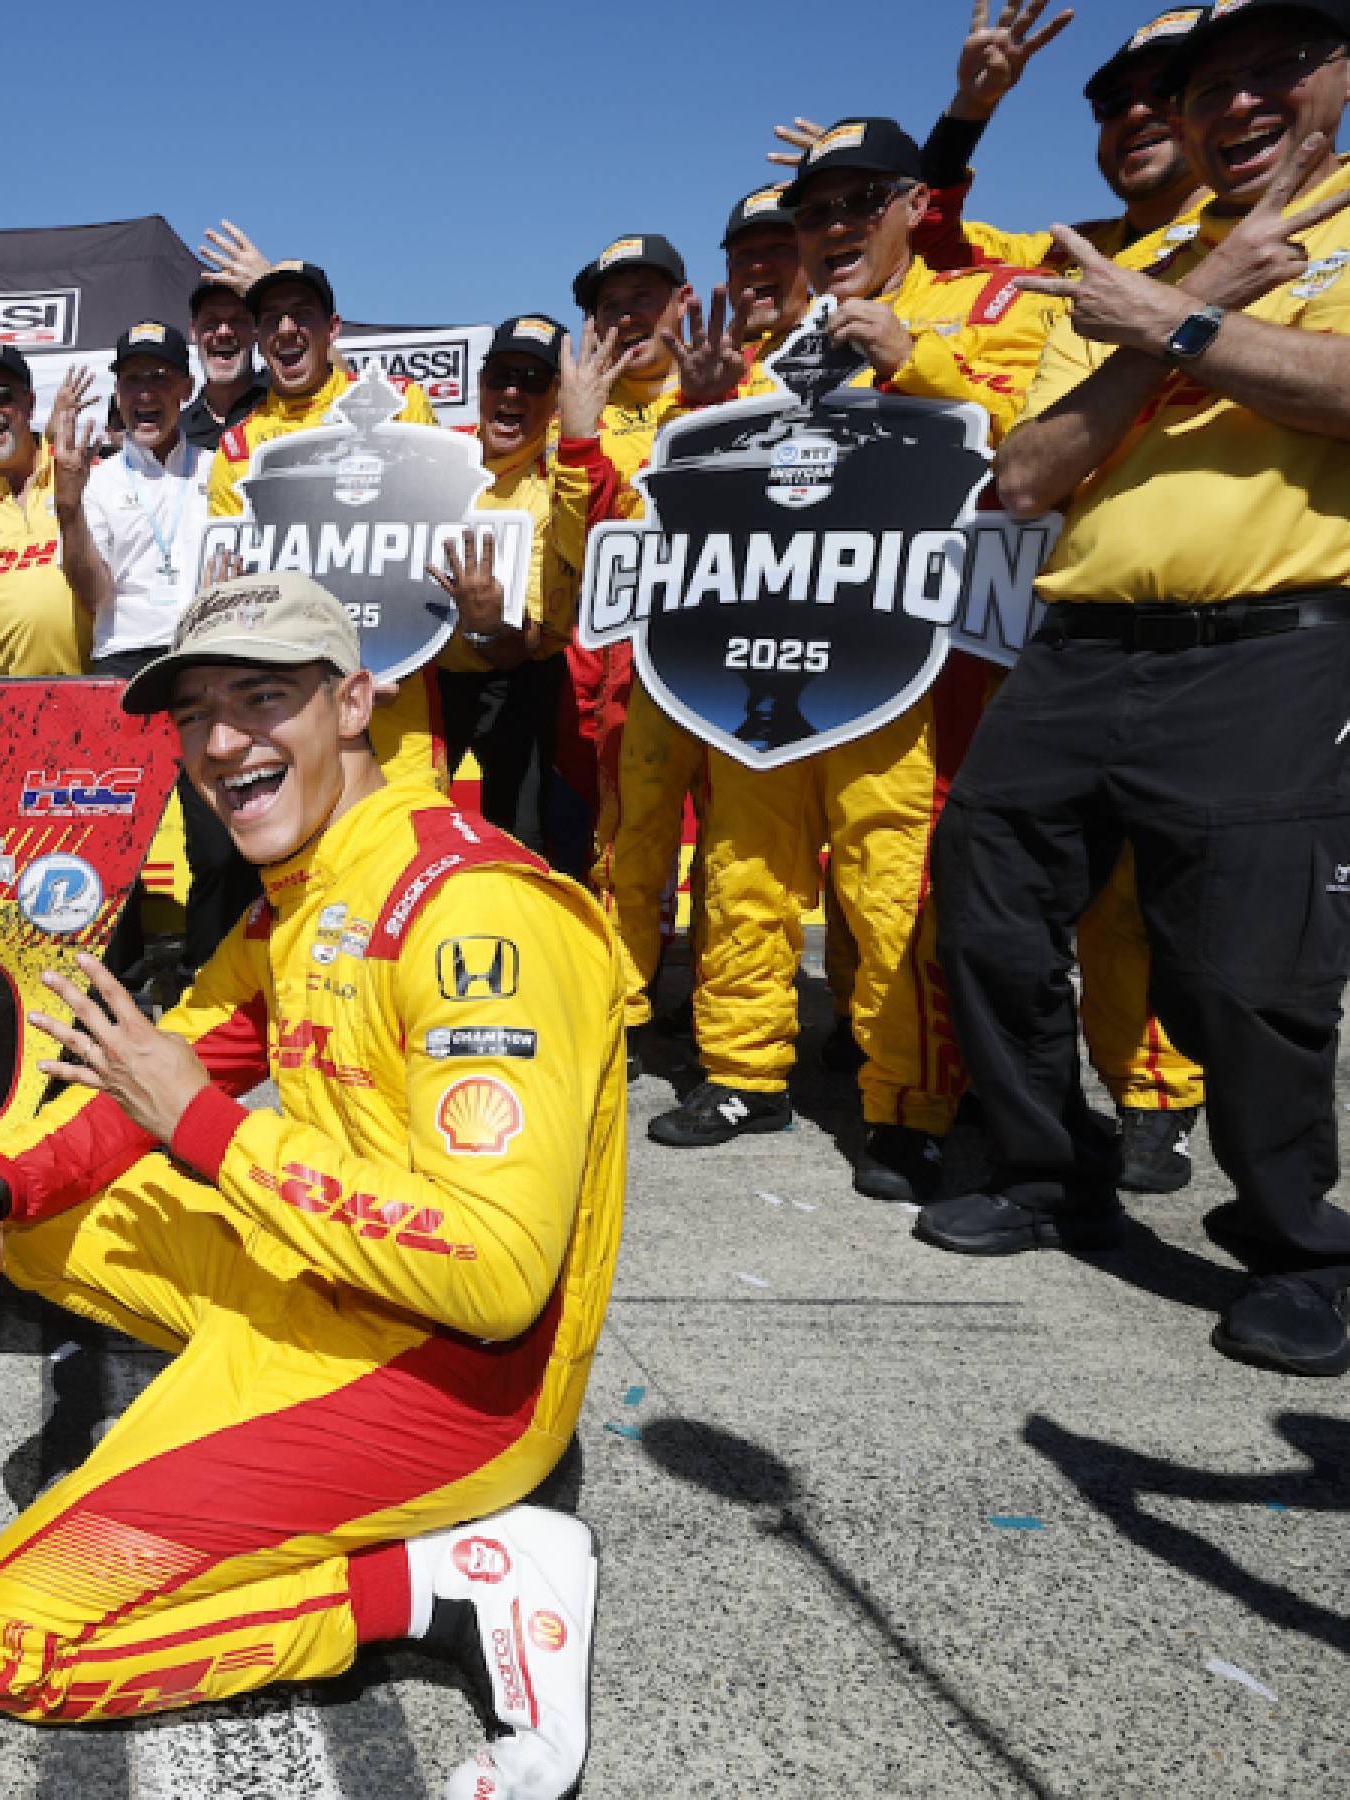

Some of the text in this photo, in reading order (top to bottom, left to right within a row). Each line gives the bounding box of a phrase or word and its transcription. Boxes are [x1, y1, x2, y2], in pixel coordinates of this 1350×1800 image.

[347, 602, 381, 628] 25
[591, 527, 1046, 652] CHAMPION
[723, 636, 831, 673] 2025
[279, 1161, 453, 1255] DHL
